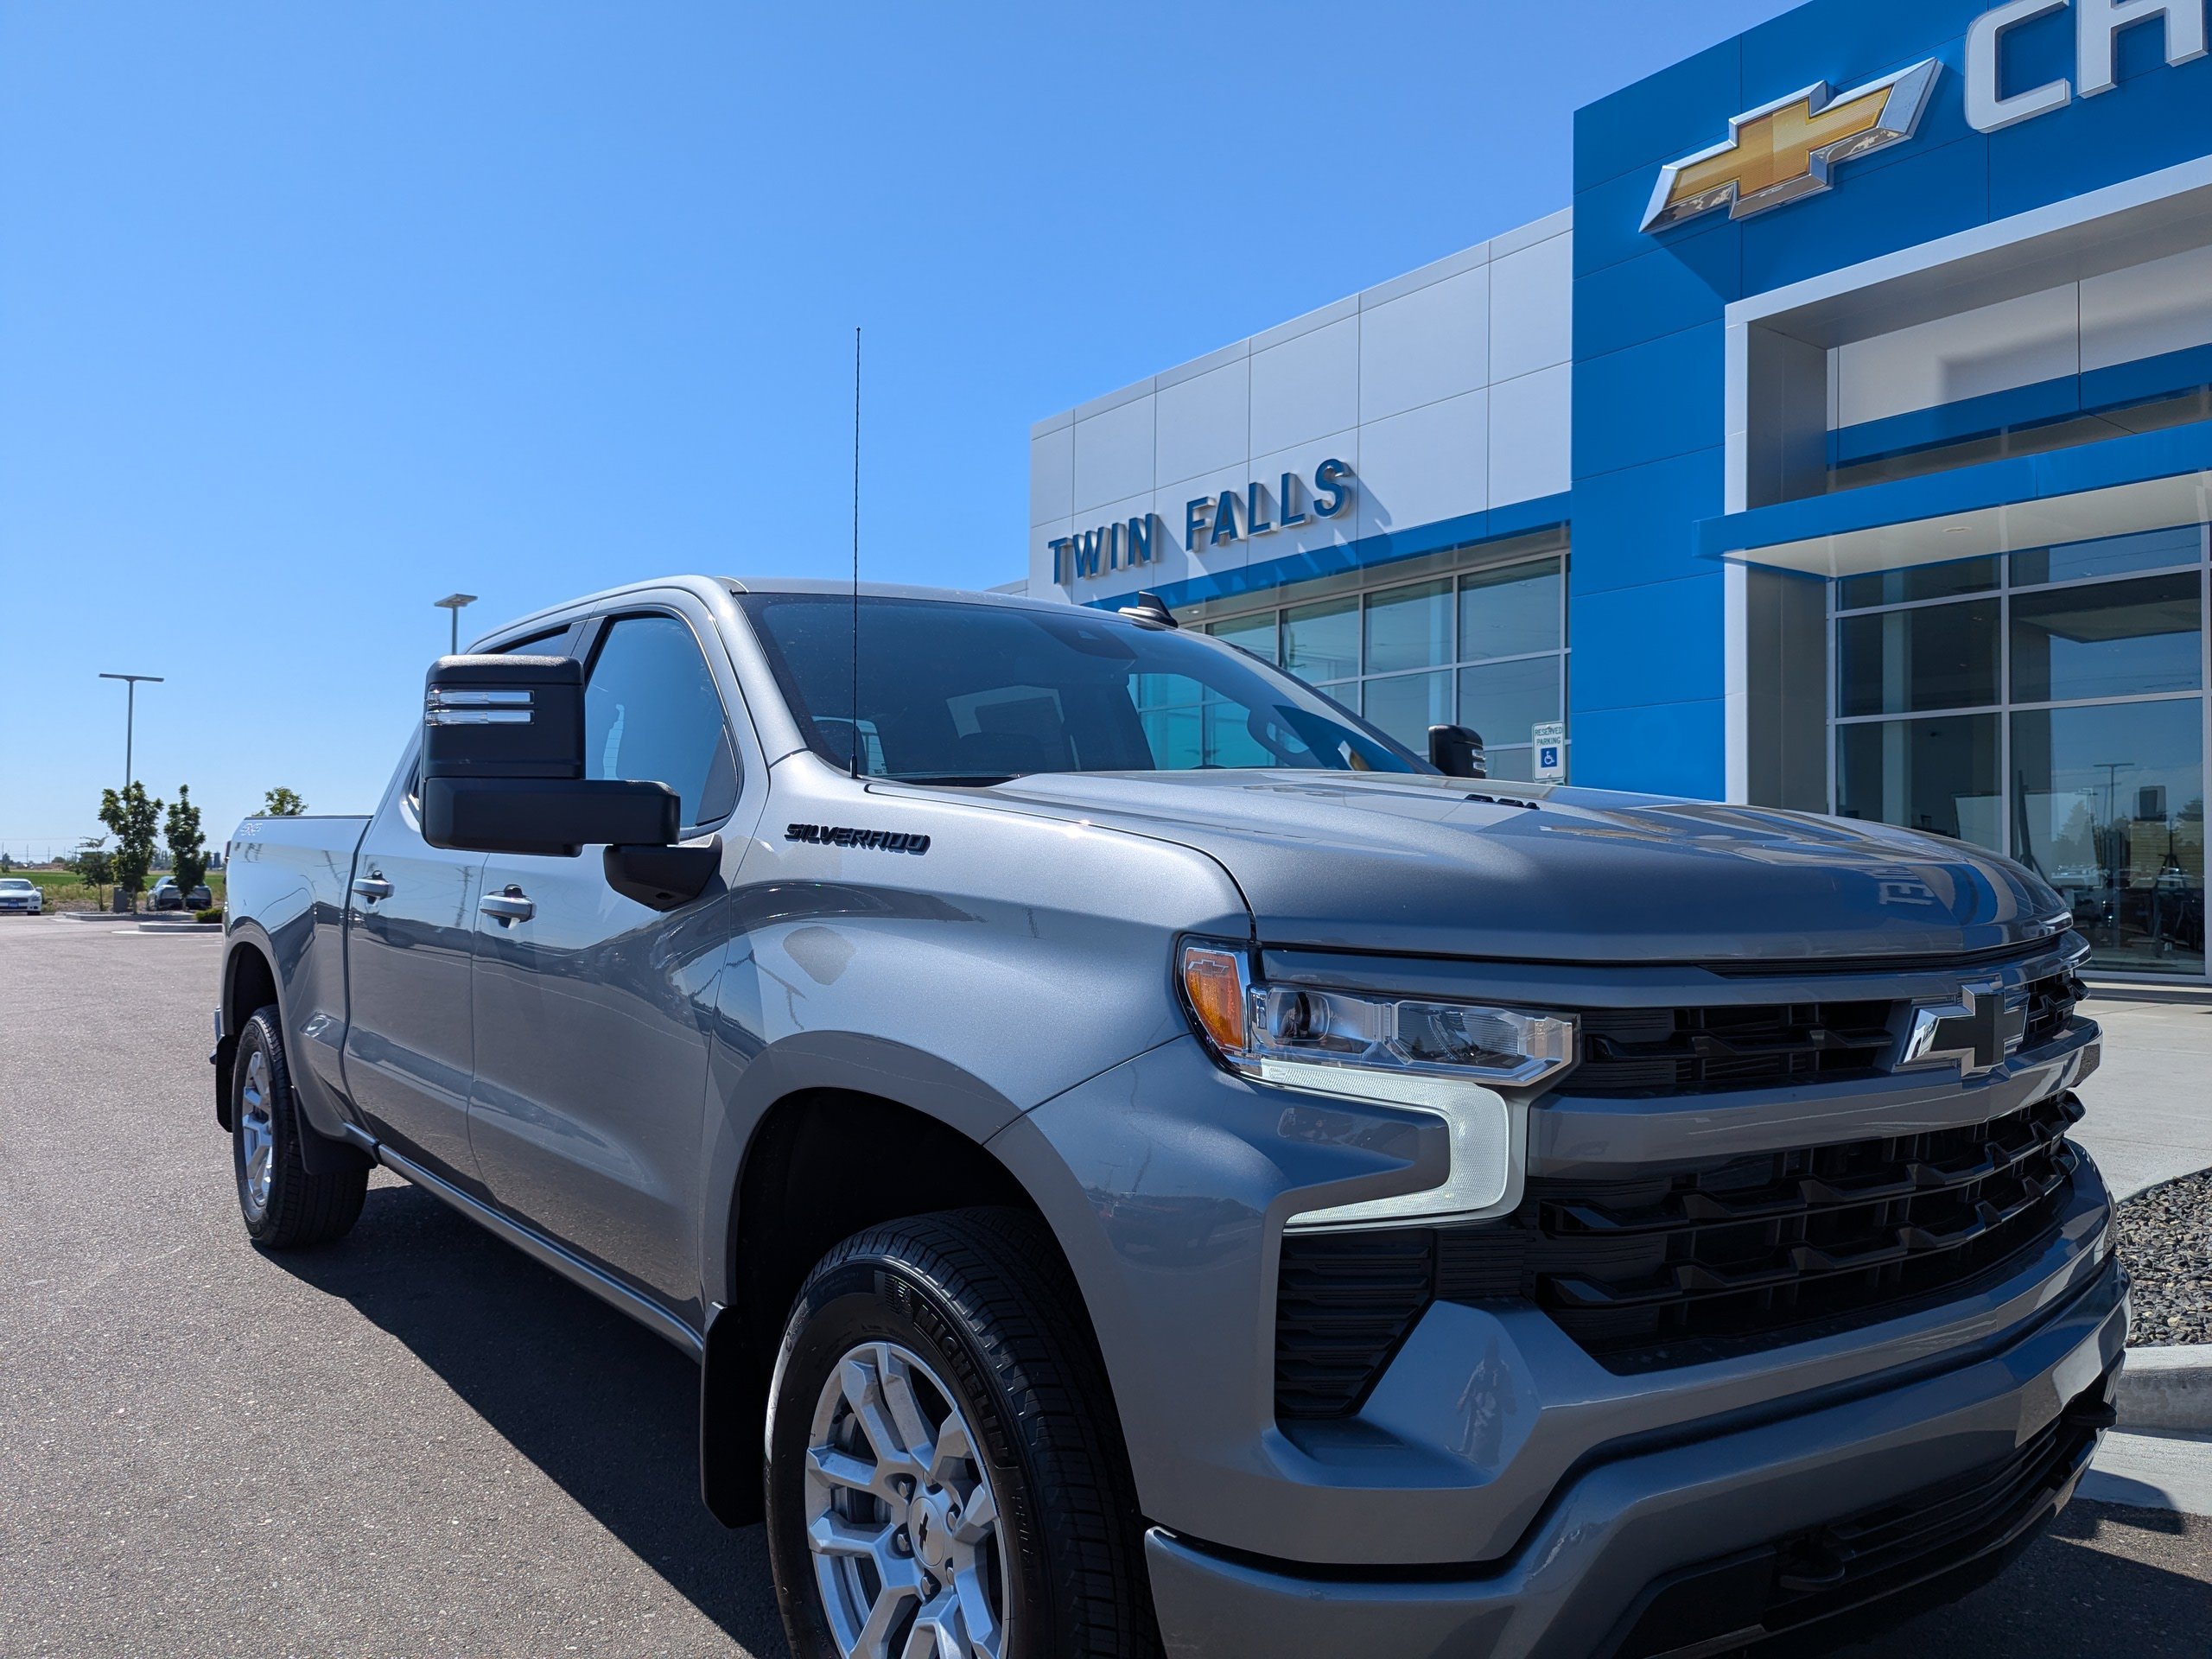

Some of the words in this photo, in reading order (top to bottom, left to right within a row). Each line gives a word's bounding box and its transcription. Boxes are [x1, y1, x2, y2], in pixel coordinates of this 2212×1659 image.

[1048, 512, 1160, 585] TWIN
[1186, 458, 1351, 552] FALLS
[1534, 727, 1562, 736] RESERVED
[1536, 736, 1561, 746] PARKING
[785, 823, 931, 855] SILVERADO
[914, 1303, 1009, 1460] MICHELIN
